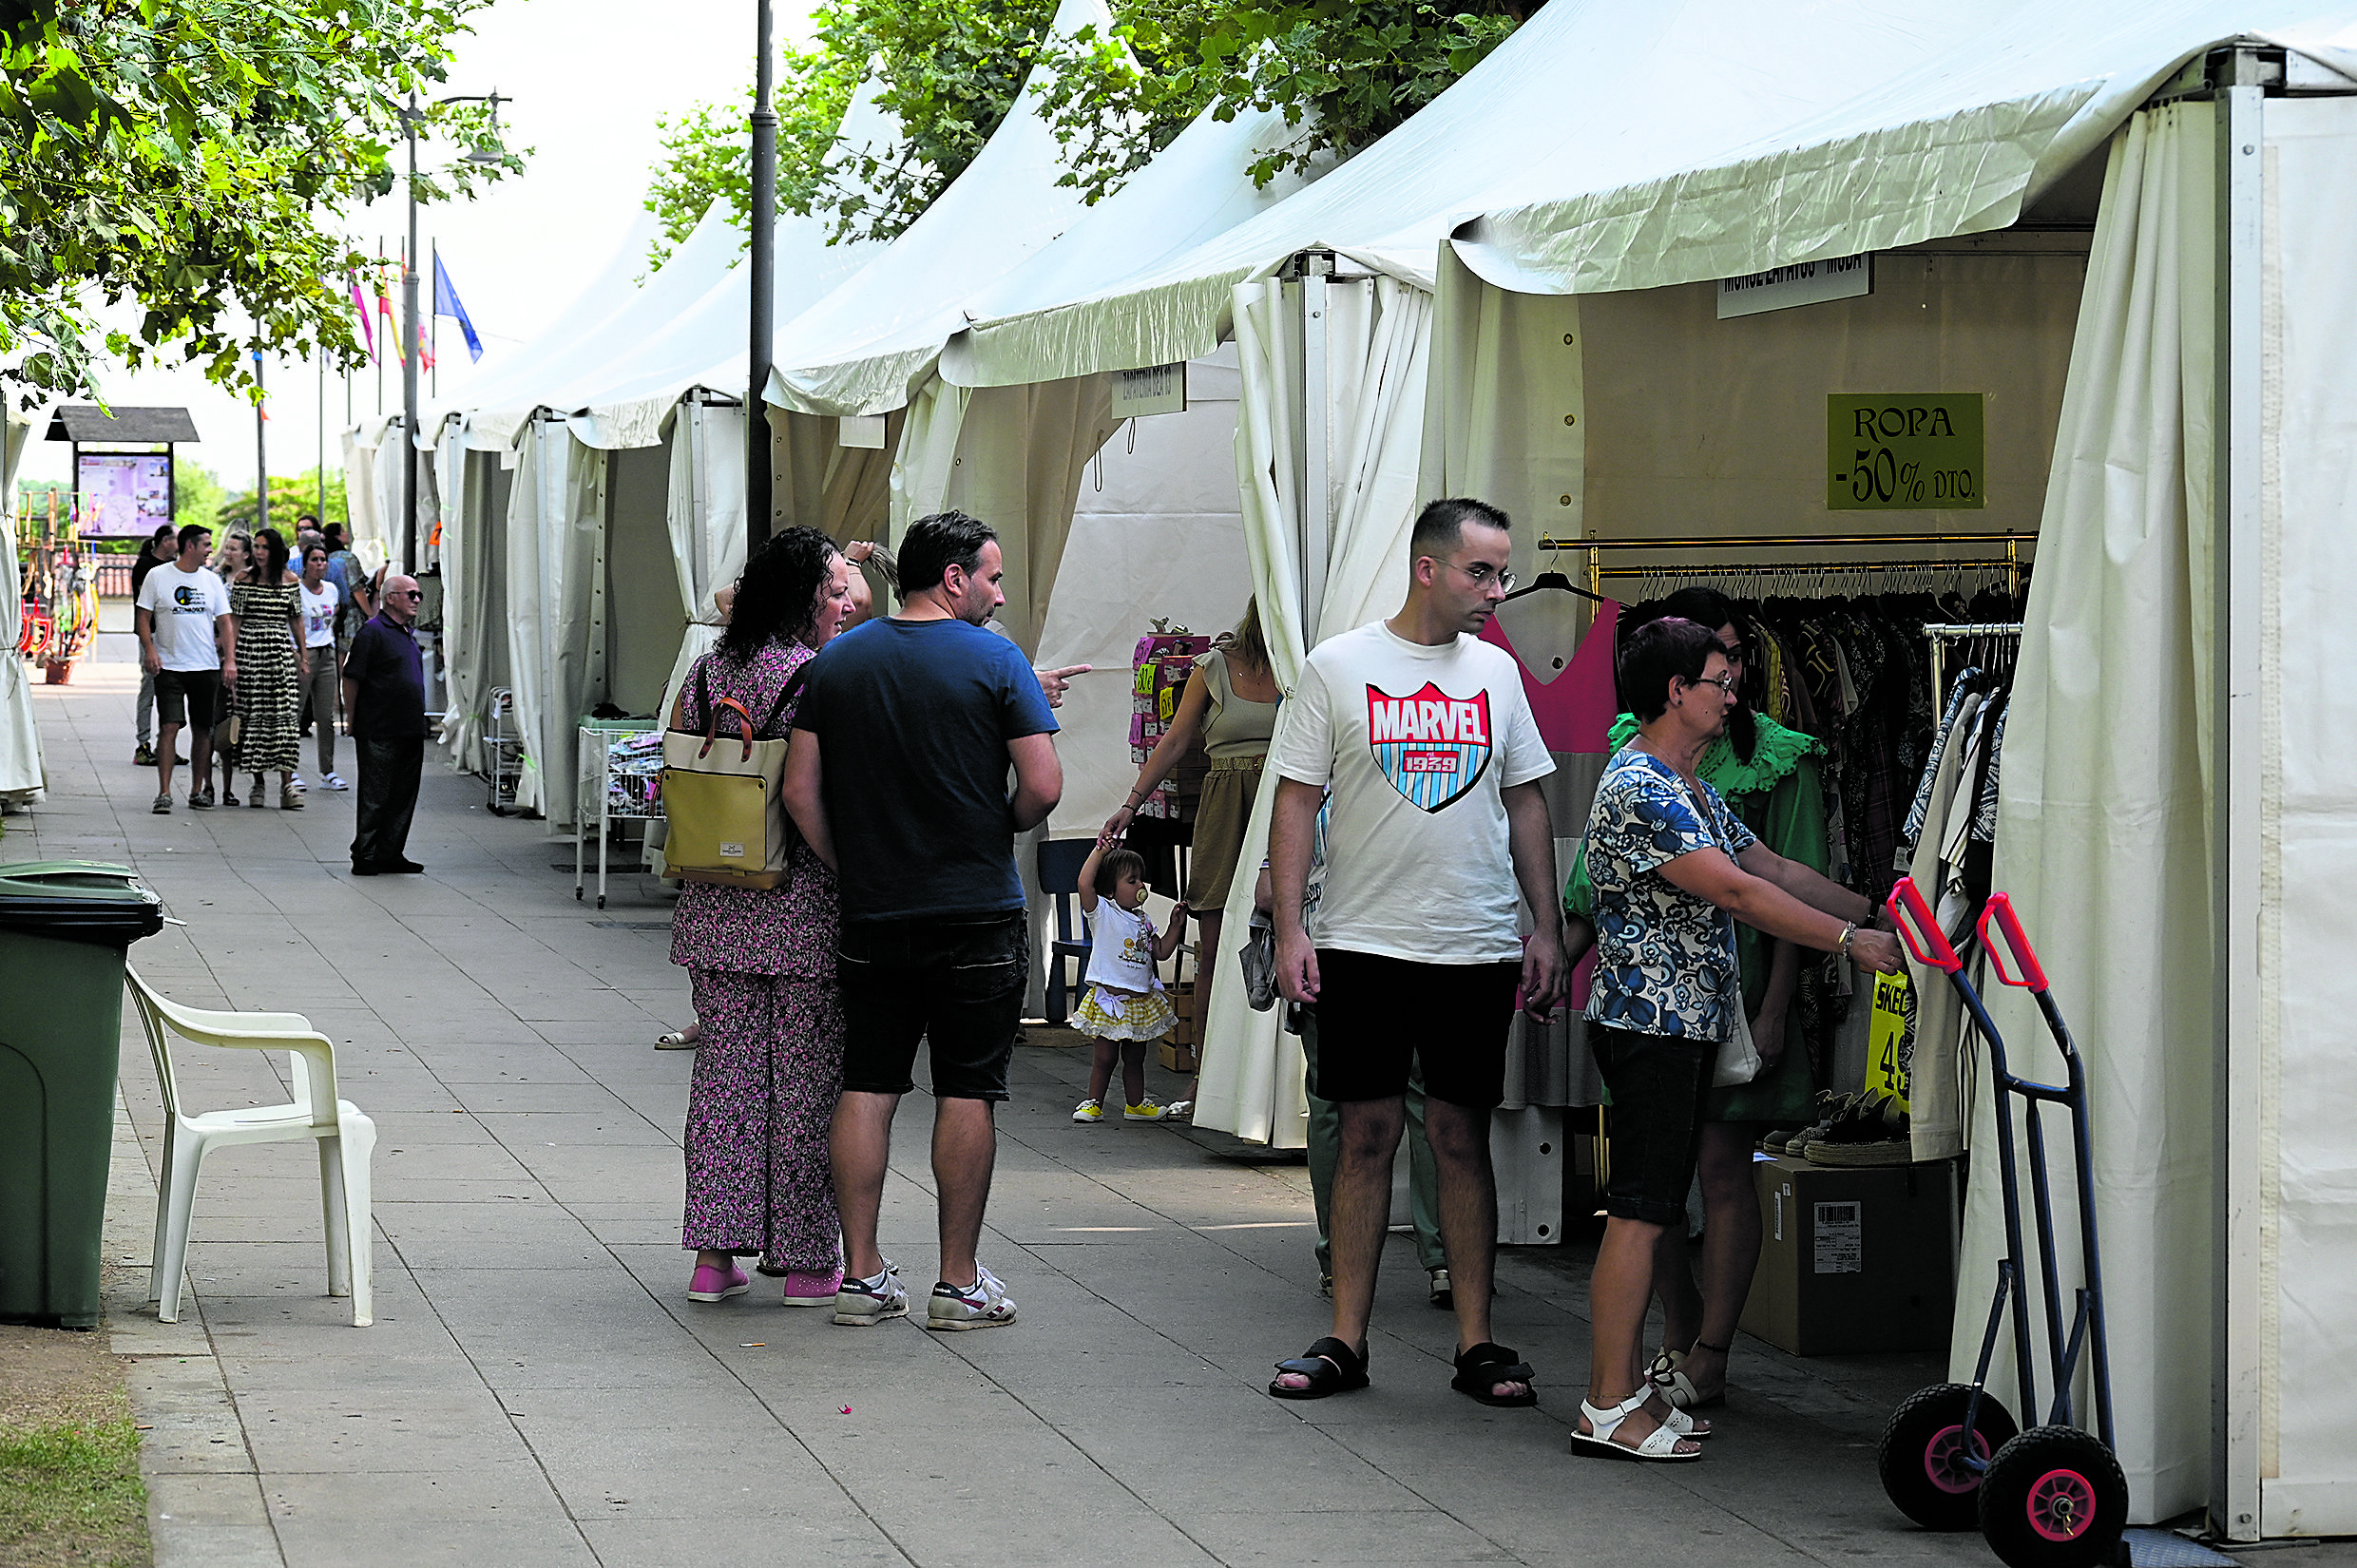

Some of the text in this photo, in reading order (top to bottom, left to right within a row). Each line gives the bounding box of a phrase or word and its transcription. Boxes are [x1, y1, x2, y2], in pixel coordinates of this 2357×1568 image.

[1852, 407, 1956, 444] ROPA
[1835, 447, 1976, 504] -50% DTO.
[1371, 699, 1486, 743] MARVEL
[1405, 756, 1458, 772] 1939
